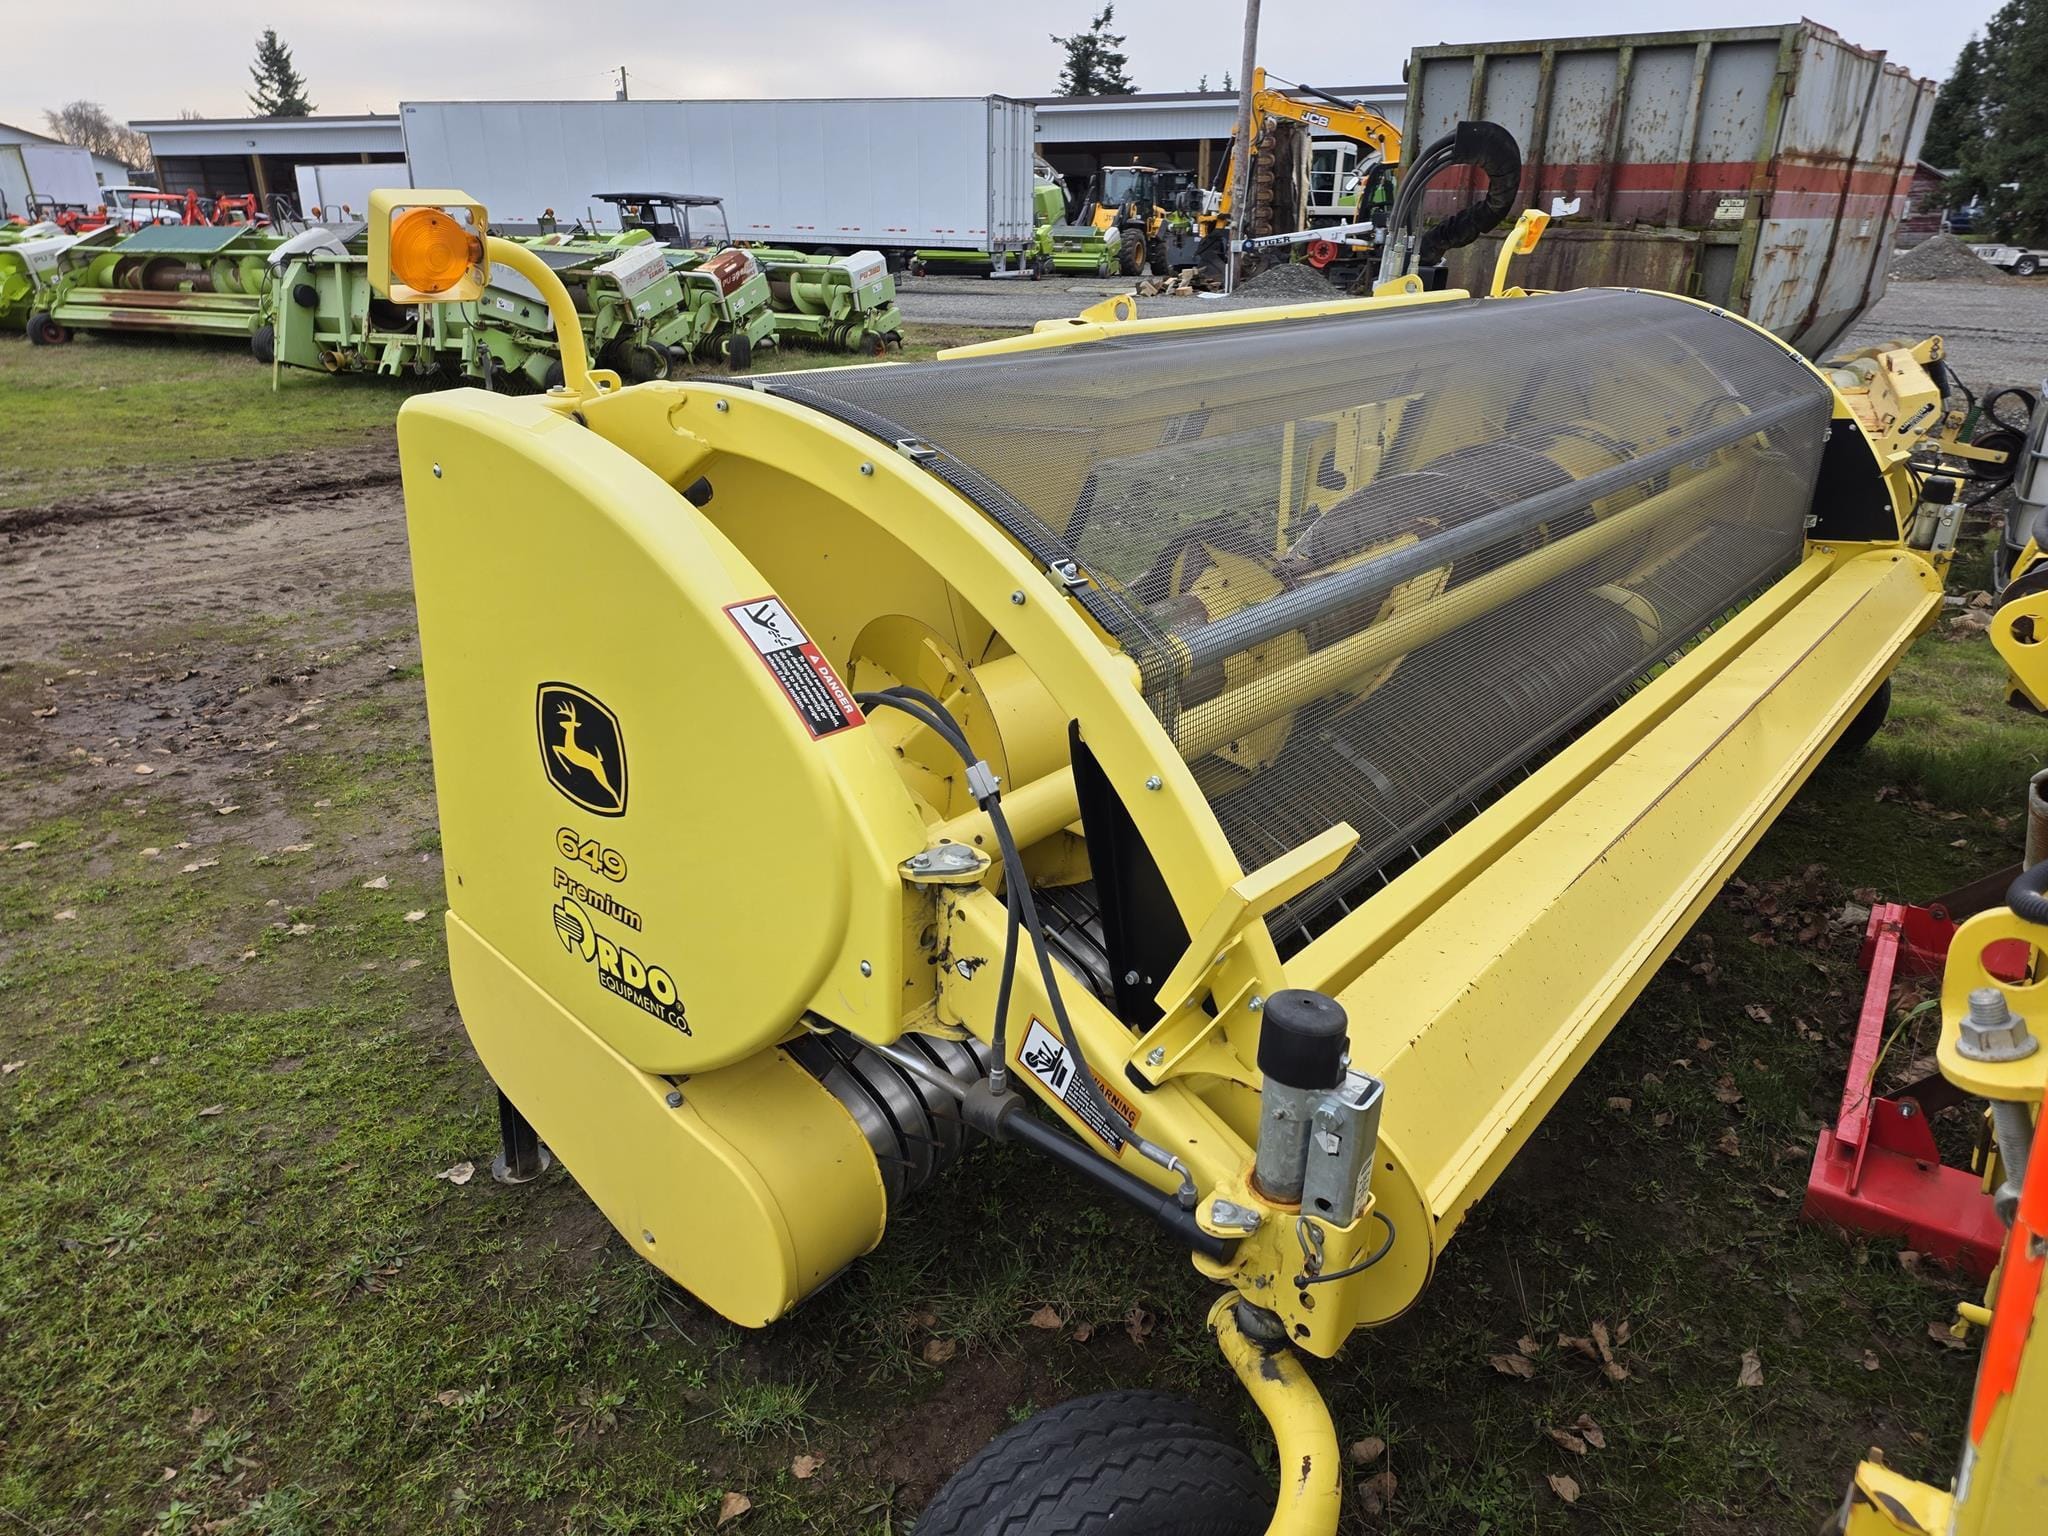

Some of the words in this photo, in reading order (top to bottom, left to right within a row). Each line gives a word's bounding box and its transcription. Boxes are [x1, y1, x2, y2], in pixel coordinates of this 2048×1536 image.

[1301, 112, 1329, 127] JCB
[1258, 236, 1290, 246] TIGER
[766, 654, 779, 670] when
[788, 688, 805, 710] motion.
[772, 653, 790, 676] clothing
[799, 690, 810, 704] near
[808, 704, 822, 722] auger
[785, 659, 794, 670] not
[792, 670, 806, 685] allow
[802, 685, 823, 712] person(s)
[791, 656, 804, 672] death
[802, 672, 814, 686] from
[803, 663, 817, 678] avoid
[814, 679, 830, 700] serious
[828, 699, 840, 716] injury
[818, 667, 854, 714] DANGER
[556, 827, 628, 883] 649
[554, 866, 643, 933] Premium
[600, 972, 666, 1019] EQUIPMENT
[668, 1011, 693, 1038] CO.
